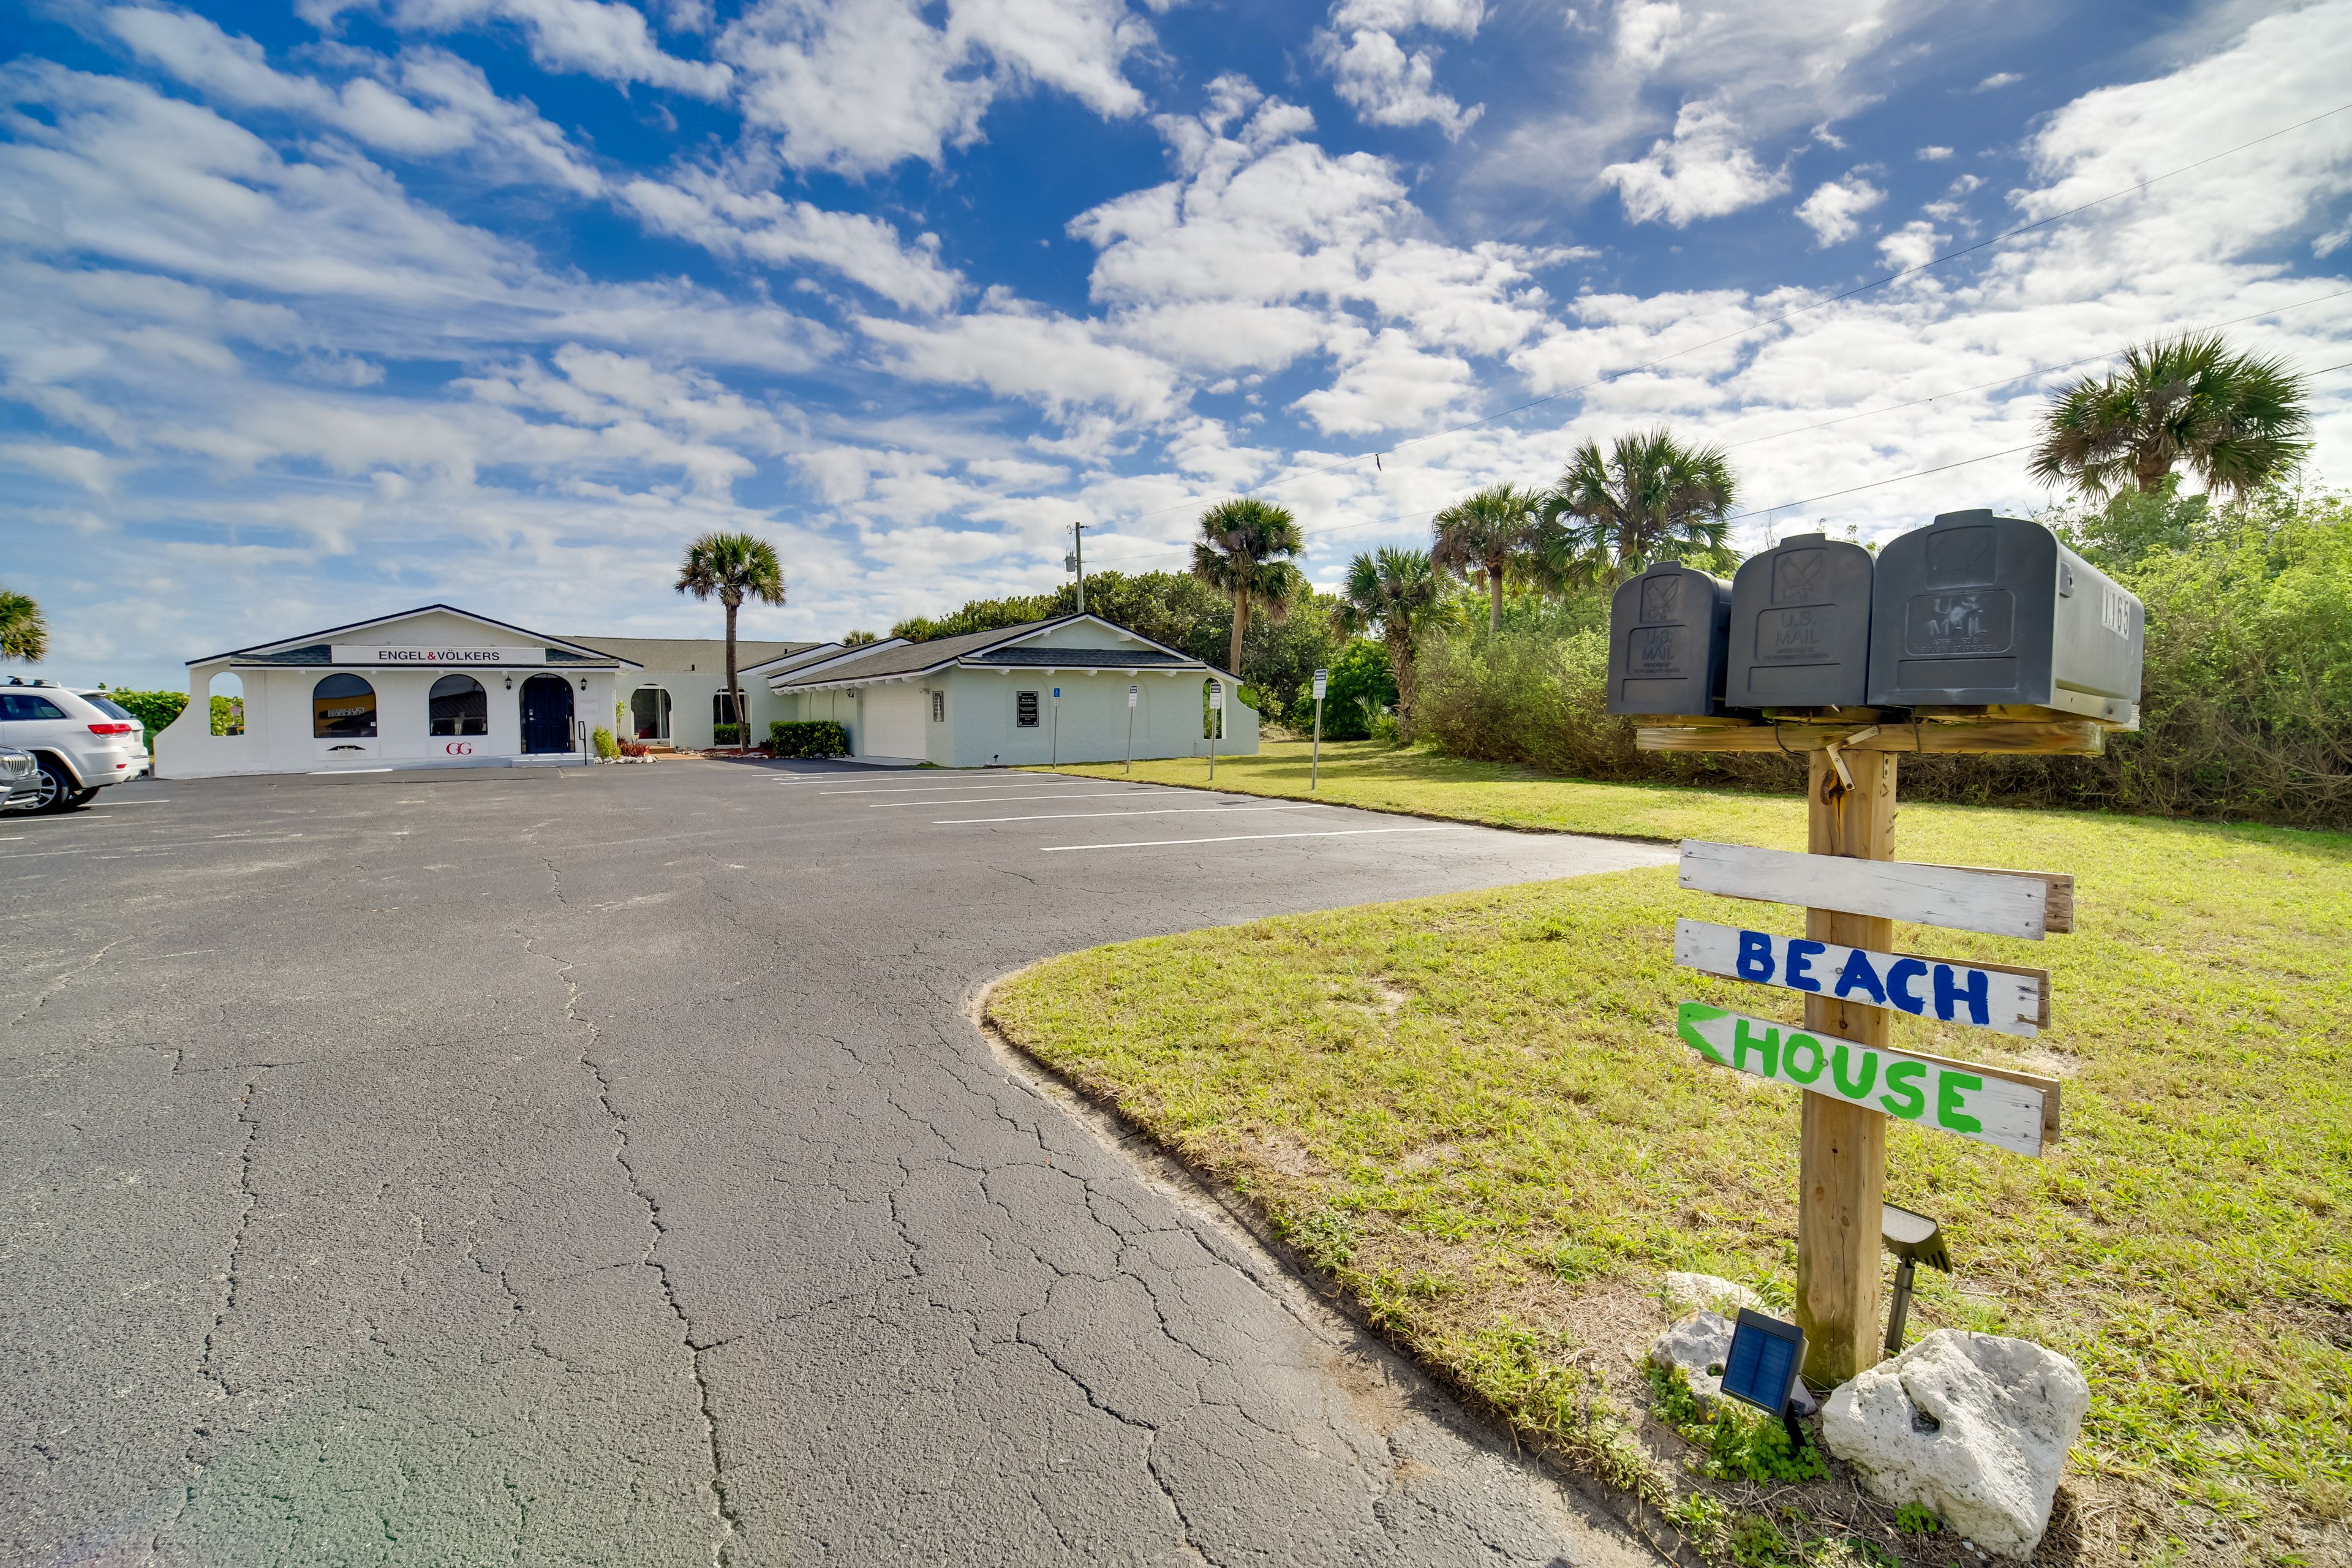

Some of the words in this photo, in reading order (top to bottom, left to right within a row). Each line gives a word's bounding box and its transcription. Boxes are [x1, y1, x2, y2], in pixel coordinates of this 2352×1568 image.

[1781, 611, 1816, 627] U.S.
[1929, 617, 1988, 636] MAIL
[1646, 630, 1672, 644] U.S.
[1775, 628, 1820, 645] MAIL
[1642, 646, 1674, 660] MAIL
[1736, 930, 1989, 1025] BEACH
[1733, 1019, 1983, 1133] HOUSE
